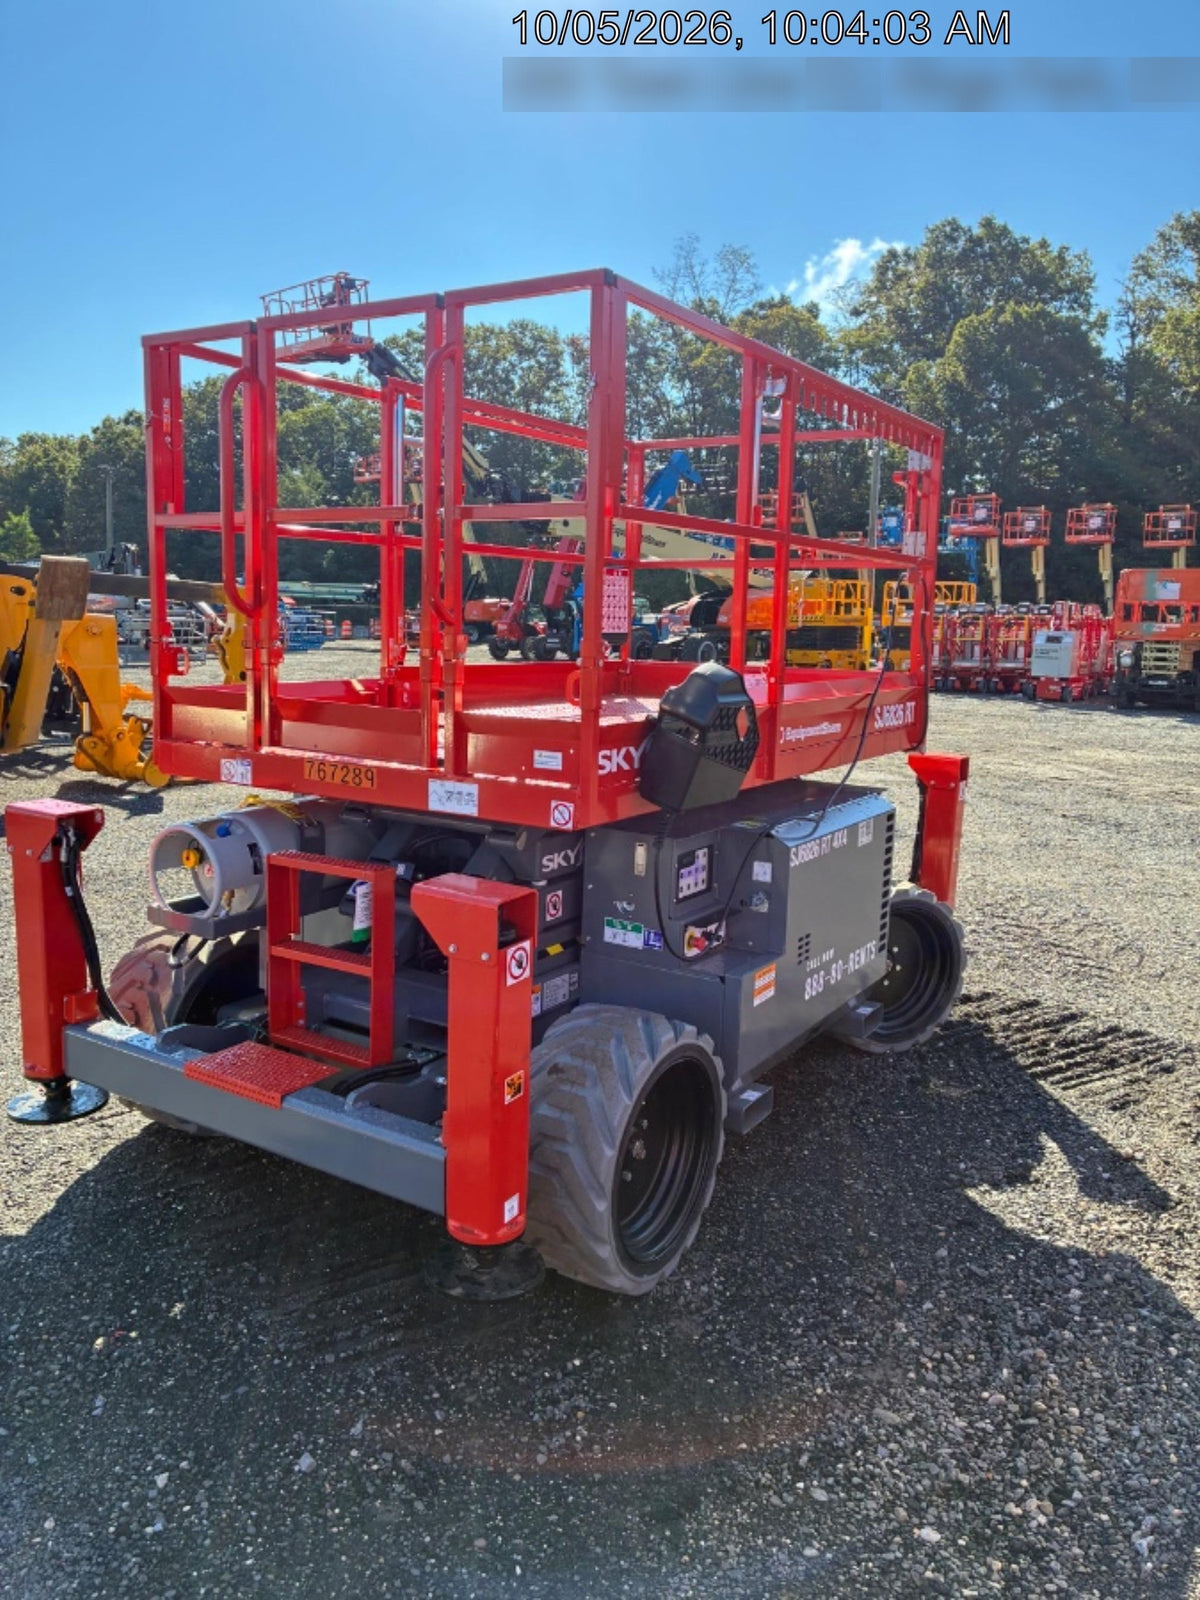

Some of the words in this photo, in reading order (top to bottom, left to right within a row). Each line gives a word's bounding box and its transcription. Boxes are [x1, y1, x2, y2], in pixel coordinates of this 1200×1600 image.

[904, 701, 916, 724] RT
[306, 760, 374, 788] 767289
[820, 834, 833, 856] RT
